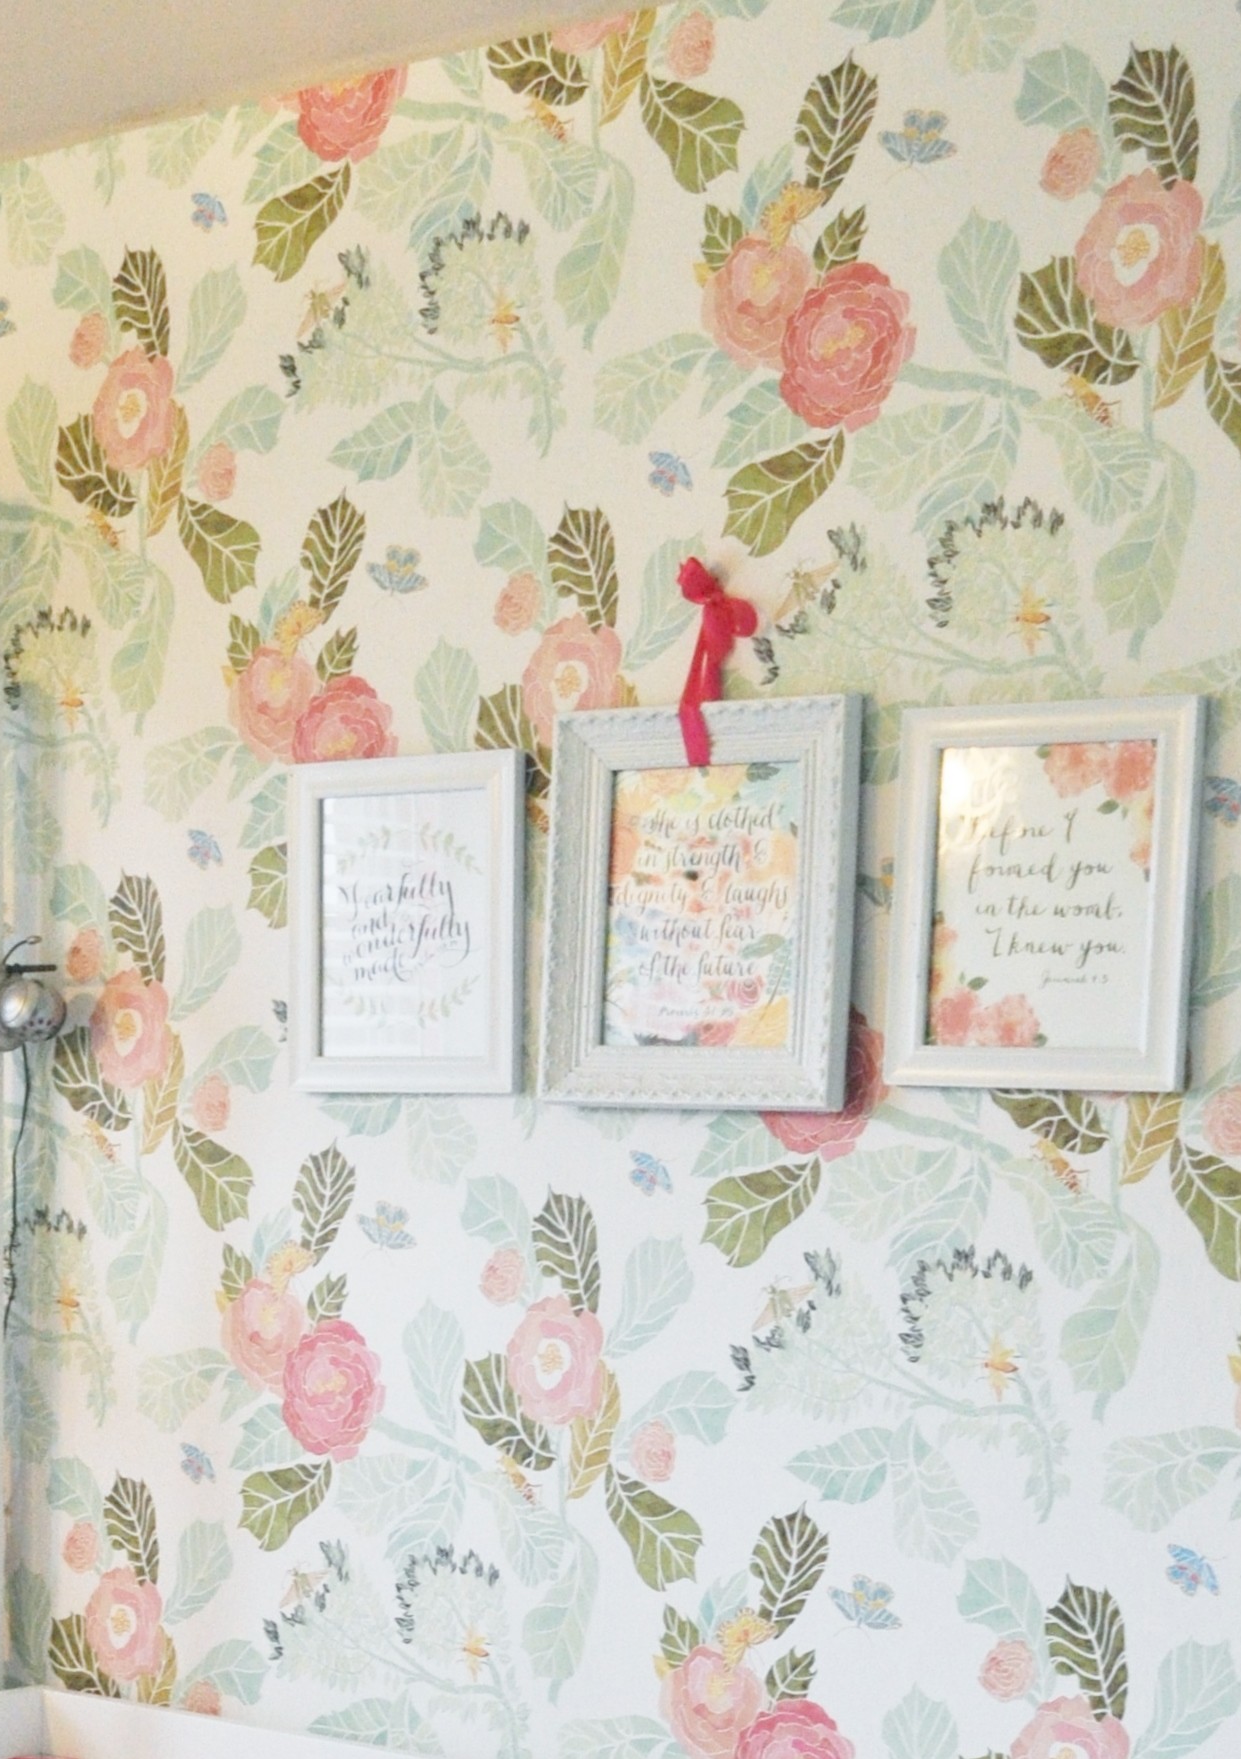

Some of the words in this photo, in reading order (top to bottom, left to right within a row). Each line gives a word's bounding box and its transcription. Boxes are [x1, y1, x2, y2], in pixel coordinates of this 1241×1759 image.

[686, 814, 699, 833] is
[708, 803, 777, 836] clothed
[959, 815, 1055, 856] efore
[637, 854, 657, 867] in
[666, 843, 741, 879] strength
[967, 852, 1059, 894] formed
[1066, 860, 1113, 890] you
[614, 881, 688, 914] dignity
[725, 878, 788, 913] laughs
[974, 904, 1003, 917] in
[1007, 894, 1047, 920] the
[640, 918, 711, 947] without
[720, 914, 756, 943] fear
[985, 926, 1003, 957] I
[1007, 931, 1073, 957] knew
[354, 947, 413, 983] made
[638, 951, 661, 982] of
[663, 955, 689, 984] the
[697, 950, 756, 983] future
